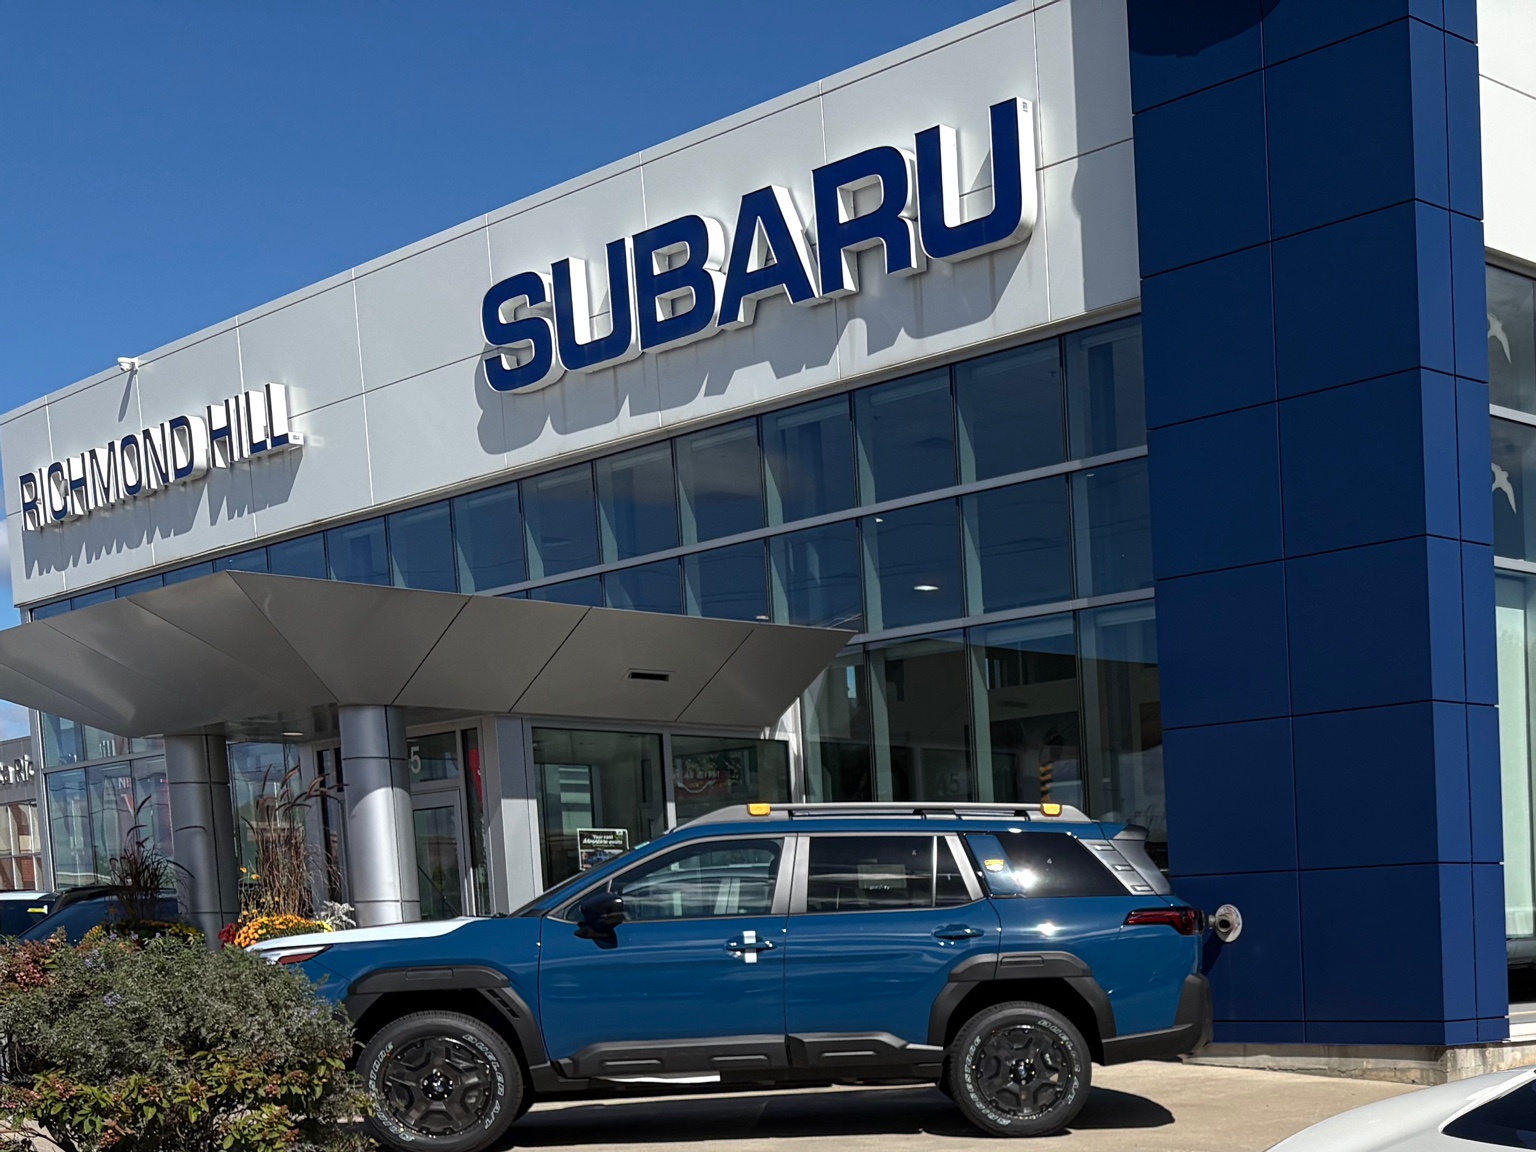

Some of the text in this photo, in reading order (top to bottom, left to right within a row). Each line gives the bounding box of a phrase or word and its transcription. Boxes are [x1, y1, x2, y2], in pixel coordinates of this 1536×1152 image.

[481, 97, 1034, 394] SUBARU
[19, 382, 299, 531] RICHMOND HILL
